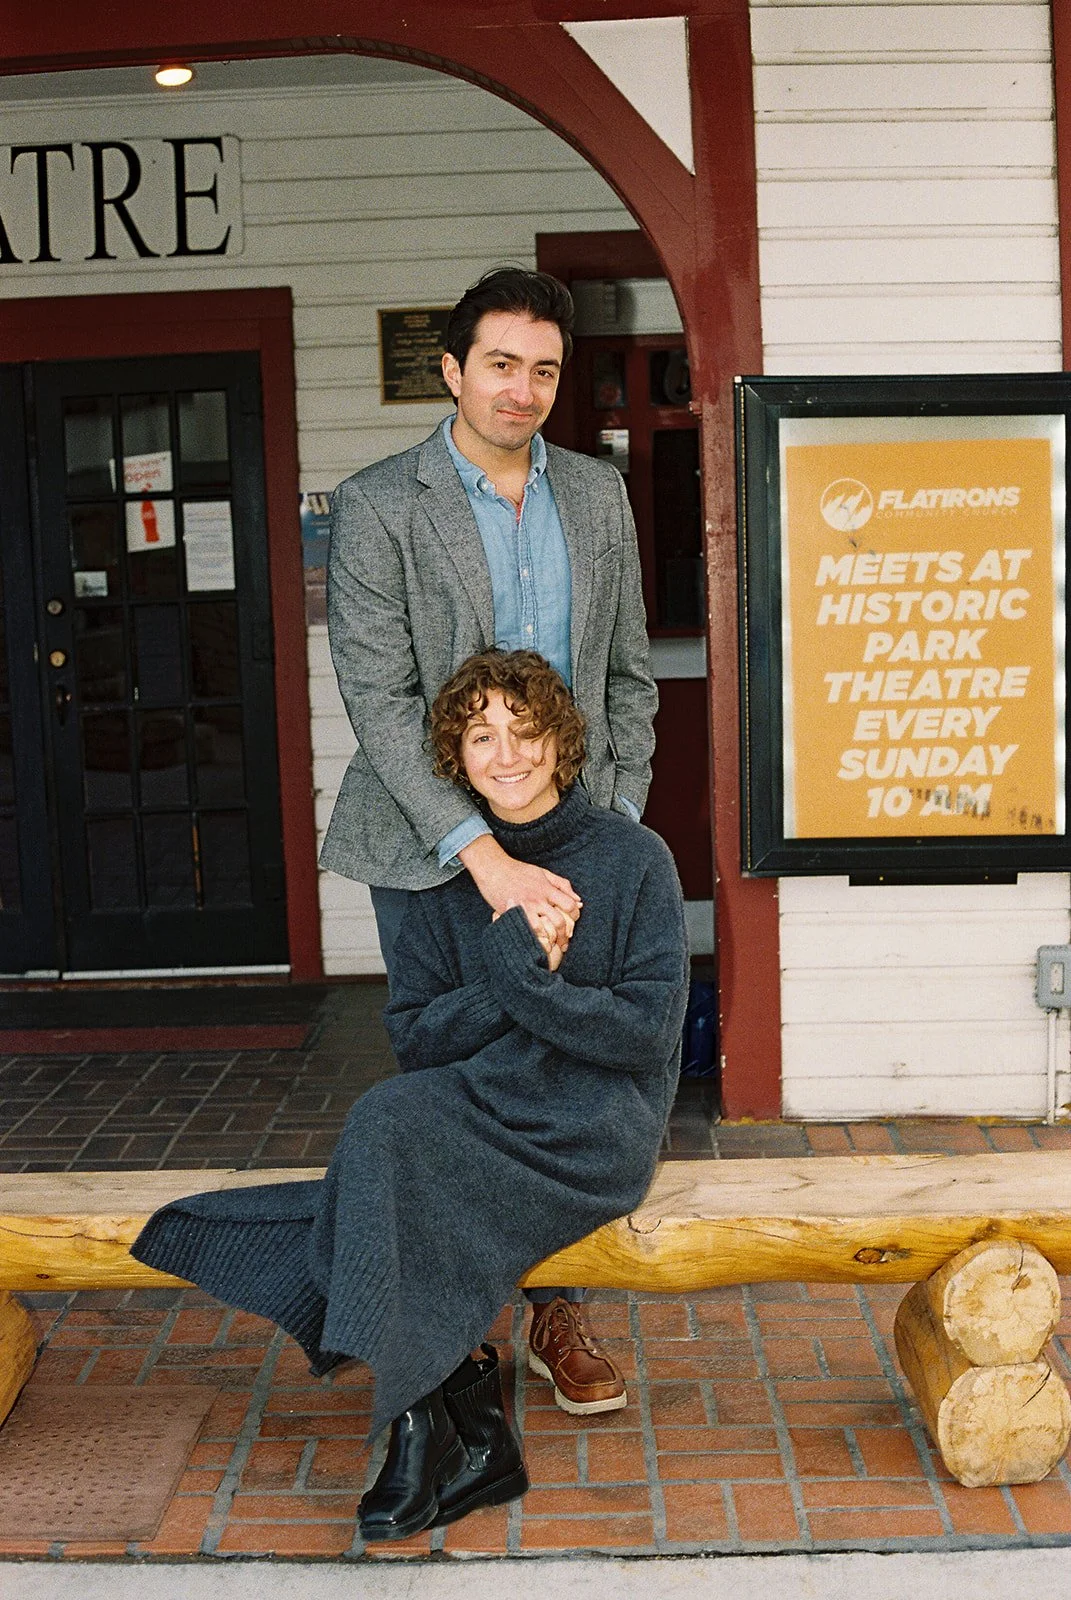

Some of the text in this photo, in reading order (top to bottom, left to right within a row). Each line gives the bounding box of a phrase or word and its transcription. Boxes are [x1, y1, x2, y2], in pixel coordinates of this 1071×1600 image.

[878, 486, 1020, 510] FLATIRONS
[815, 548, 1032, 587] MEETS AT
[816, 588, 1031, 625] HISTORIC
[862, 628, 988, 663] PARK
[824, 666, 1031, 703] THEATRE
[853, 706, 1002, 741] EVERY
[838, 744, 1019, 780] SUNDAY
[866, 783, 993, 818] 10 AM
